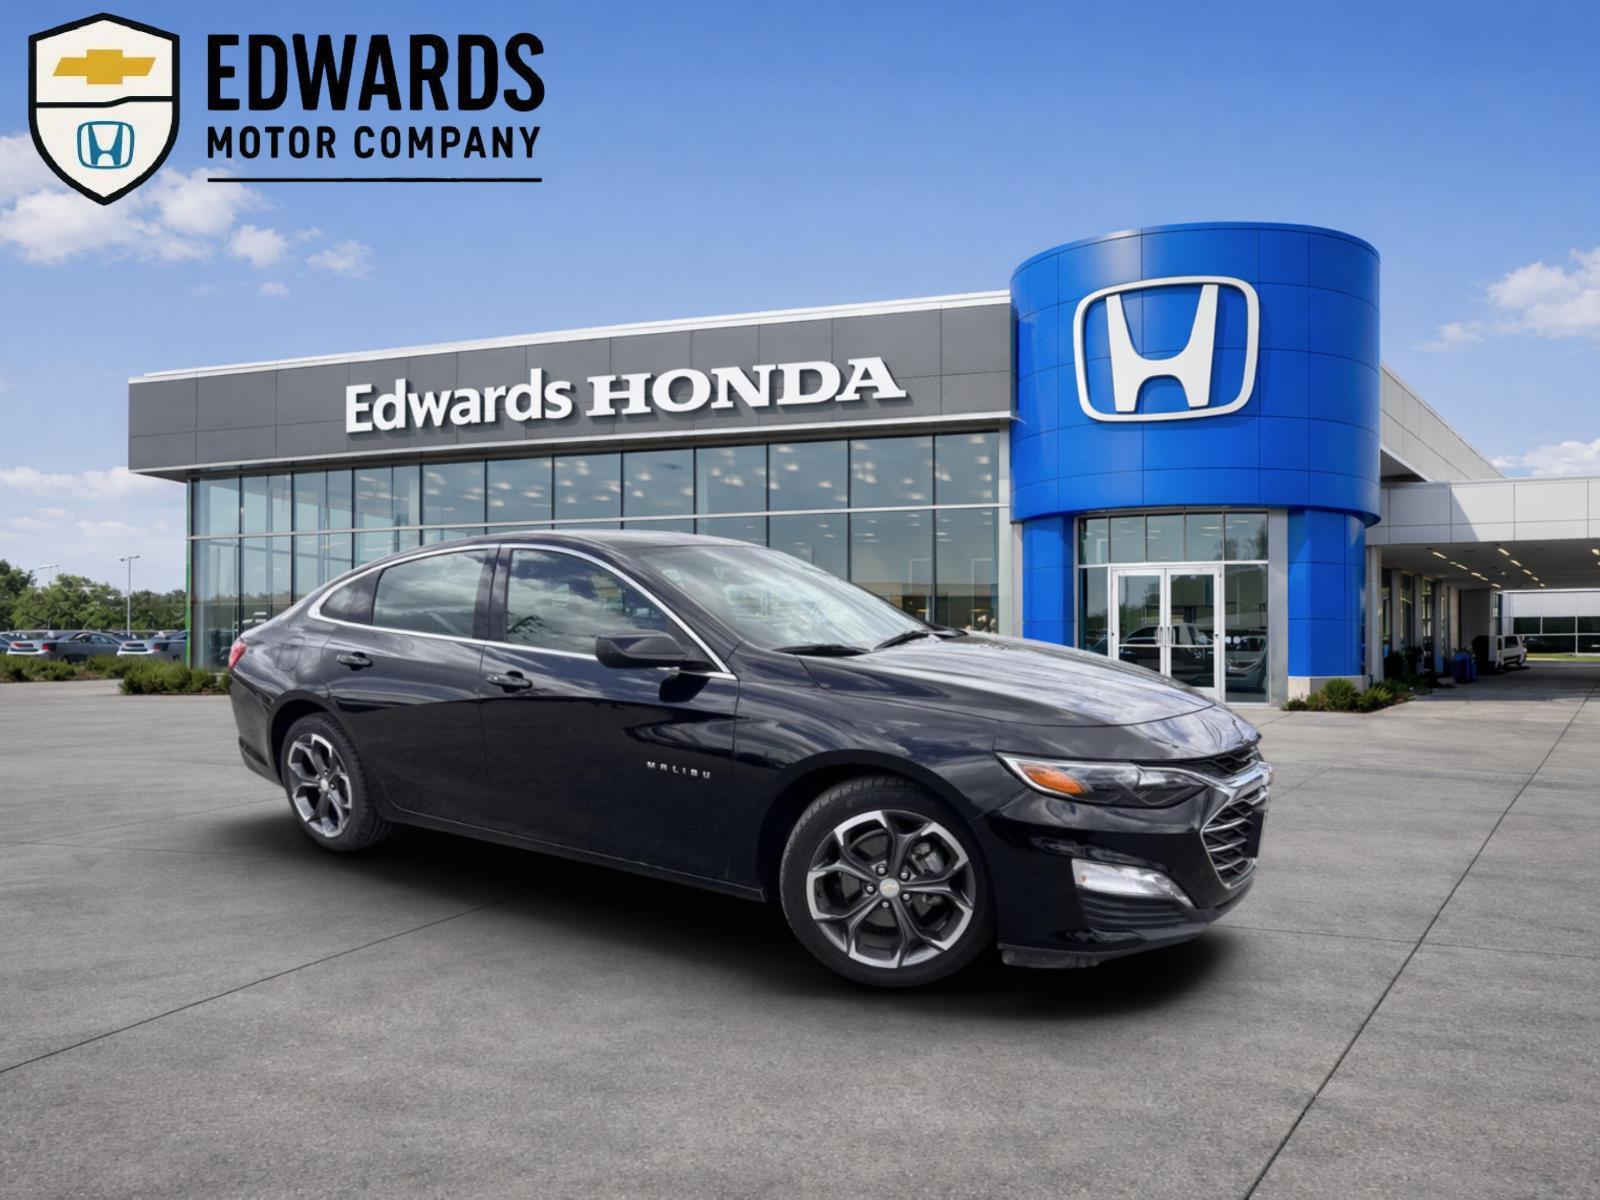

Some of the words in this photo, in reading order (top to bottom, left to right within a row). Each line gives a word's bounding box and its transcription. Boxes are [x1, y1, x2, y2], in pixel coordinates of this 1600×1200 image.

[345, 367, 572, 433] Edwards
[586, 356, 907, 417] HONDA
[646, 760, 711, 779] MALIBU
